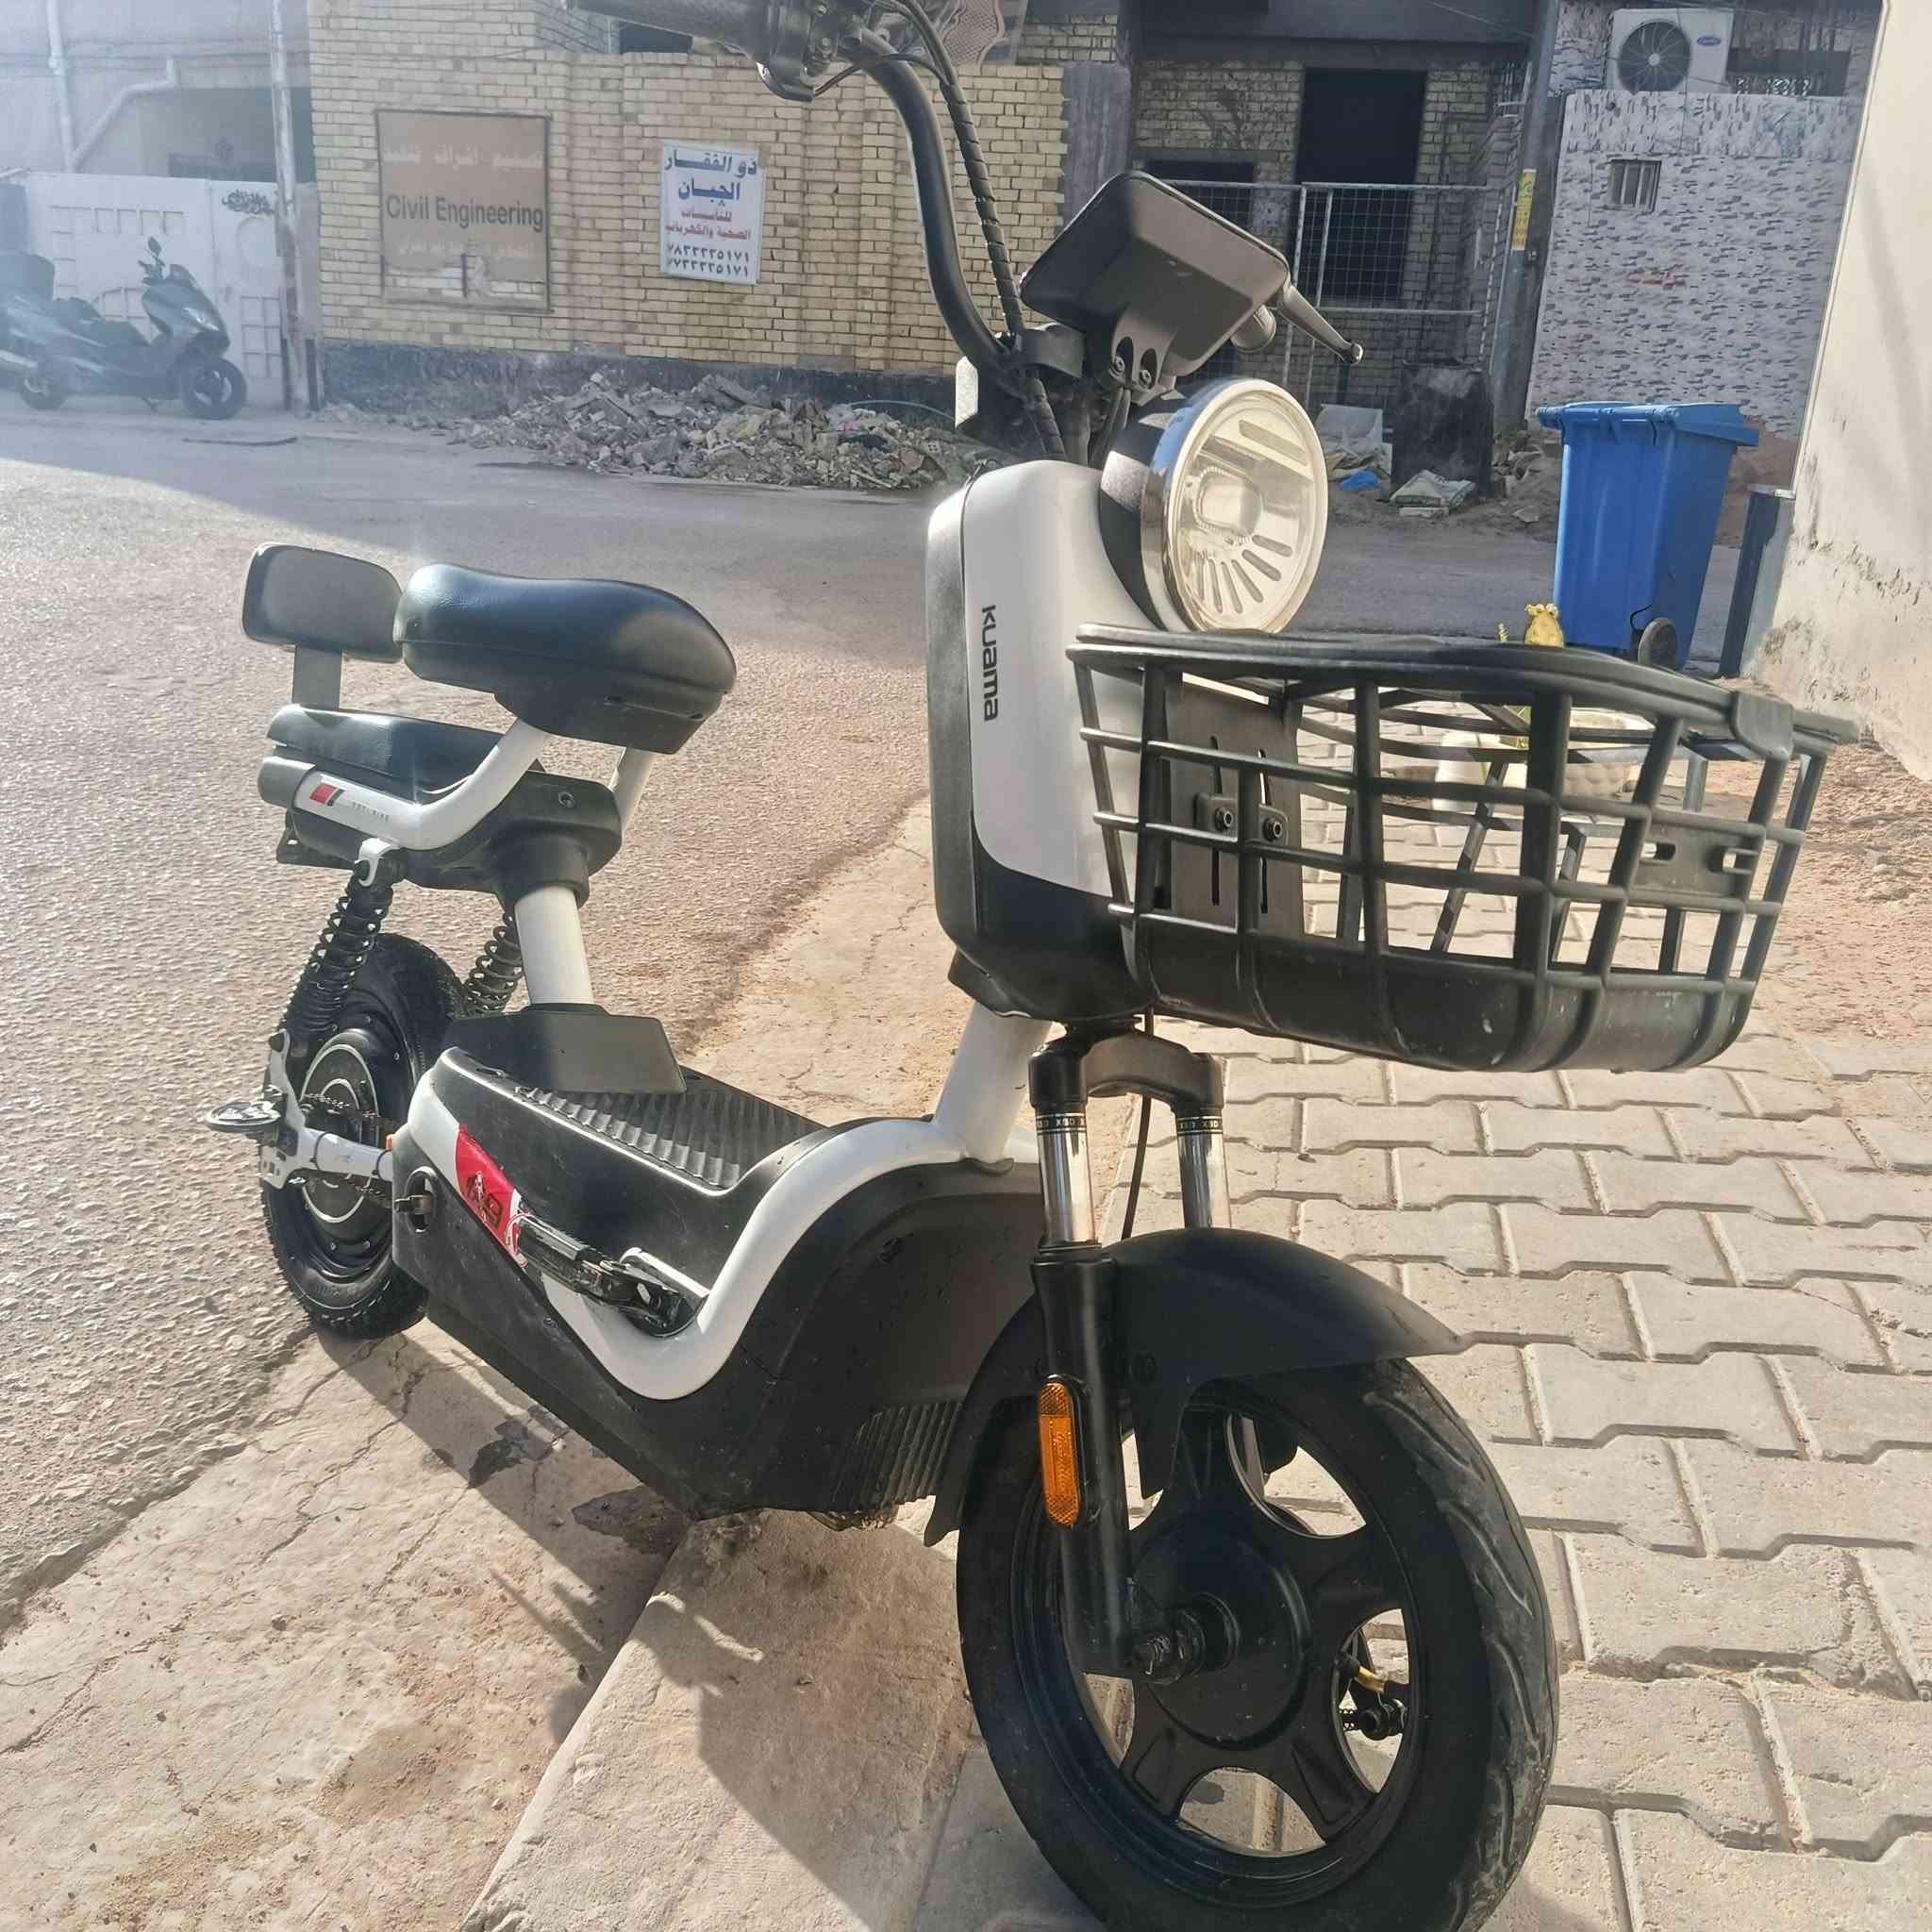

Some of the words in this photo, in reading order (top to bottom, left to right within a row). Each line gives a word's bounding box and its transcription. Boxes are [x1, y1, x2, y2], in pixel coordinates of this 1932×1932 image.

[664, 150, 732, 173] الفقار
[735, 158, 757, 179] ذو
[385, 194, 429, 220] Civil
[435, 196, 544, 233] Engineering
